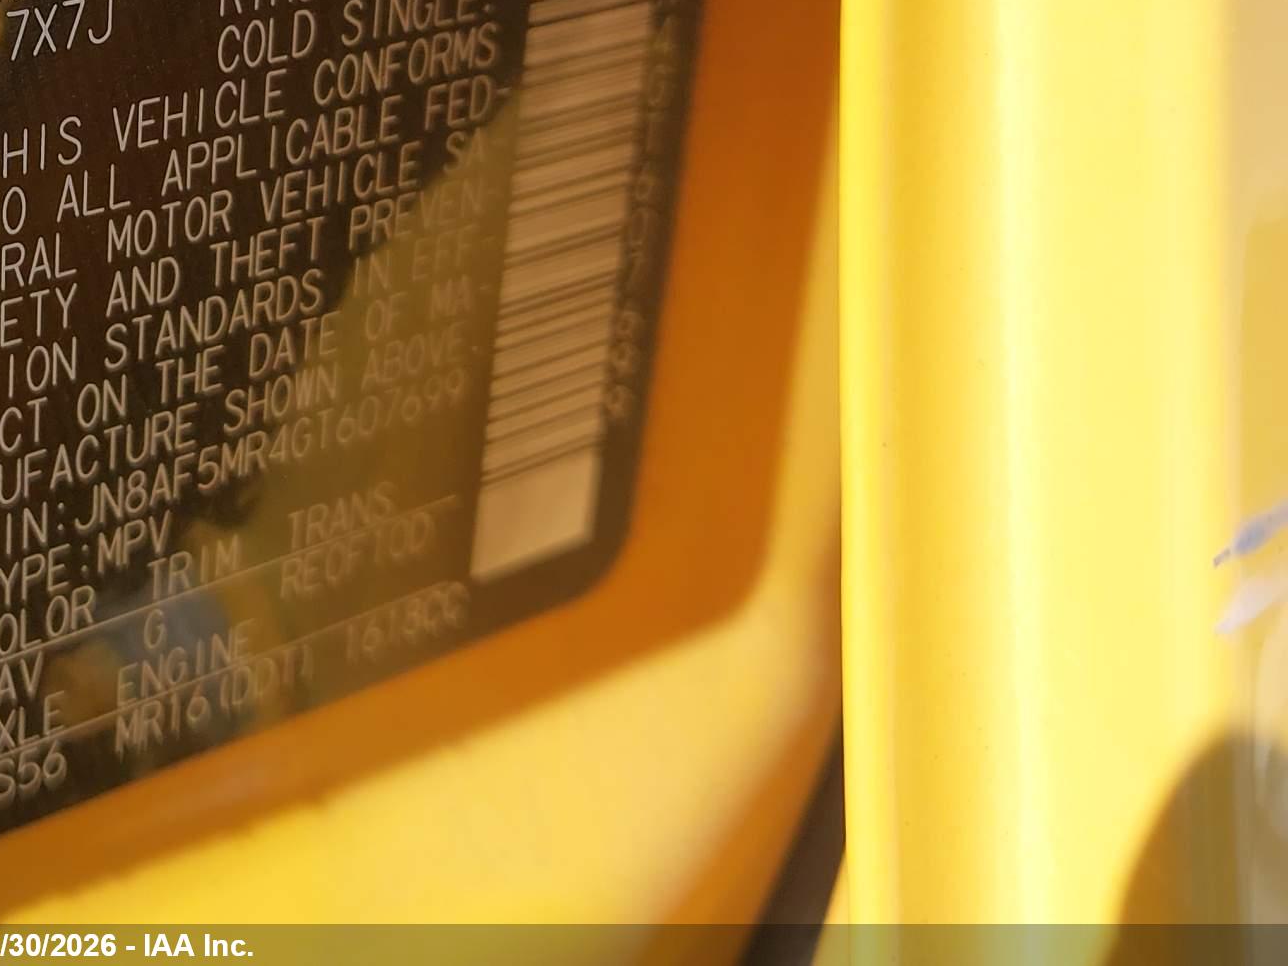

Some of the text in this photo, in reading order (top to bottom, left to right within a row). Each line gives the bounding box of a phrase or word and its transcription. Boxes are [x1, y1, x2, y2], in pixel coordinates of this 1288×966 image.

[113, 68, 288, 152] VEHICLE
[313, 22, 498, 106] CONFORMS
[218, 9, 315, 73] COLD
[56, 163, 131, 223] ALL
[161, 94, 404, 197] APPLICABLE
[425, 75, 511, 131] FED-
[108, 189, 232, 264] MOTOR
[260, 139, 422, 223] VEHICLE
[104, 268, 325, 372] STANDARDS
[352, 248, 390, 297] IN
[106, 255, 180, 318] AND
[209, 215, 326, 288] THEFT
[77, 373, 127, 429] ON
[155, 344, 224, 405] THE
[249, 310, 341, 381] DATE
[365, 291, 409, 342] OF
[223, 362, 339, 434] SHOWN
[146, 534, 241, 601] TRIM
[288, 481, 400, 549] TRANS
[117, 618, 256, 707] ENGINE
[143, 608, 167, 650] G
